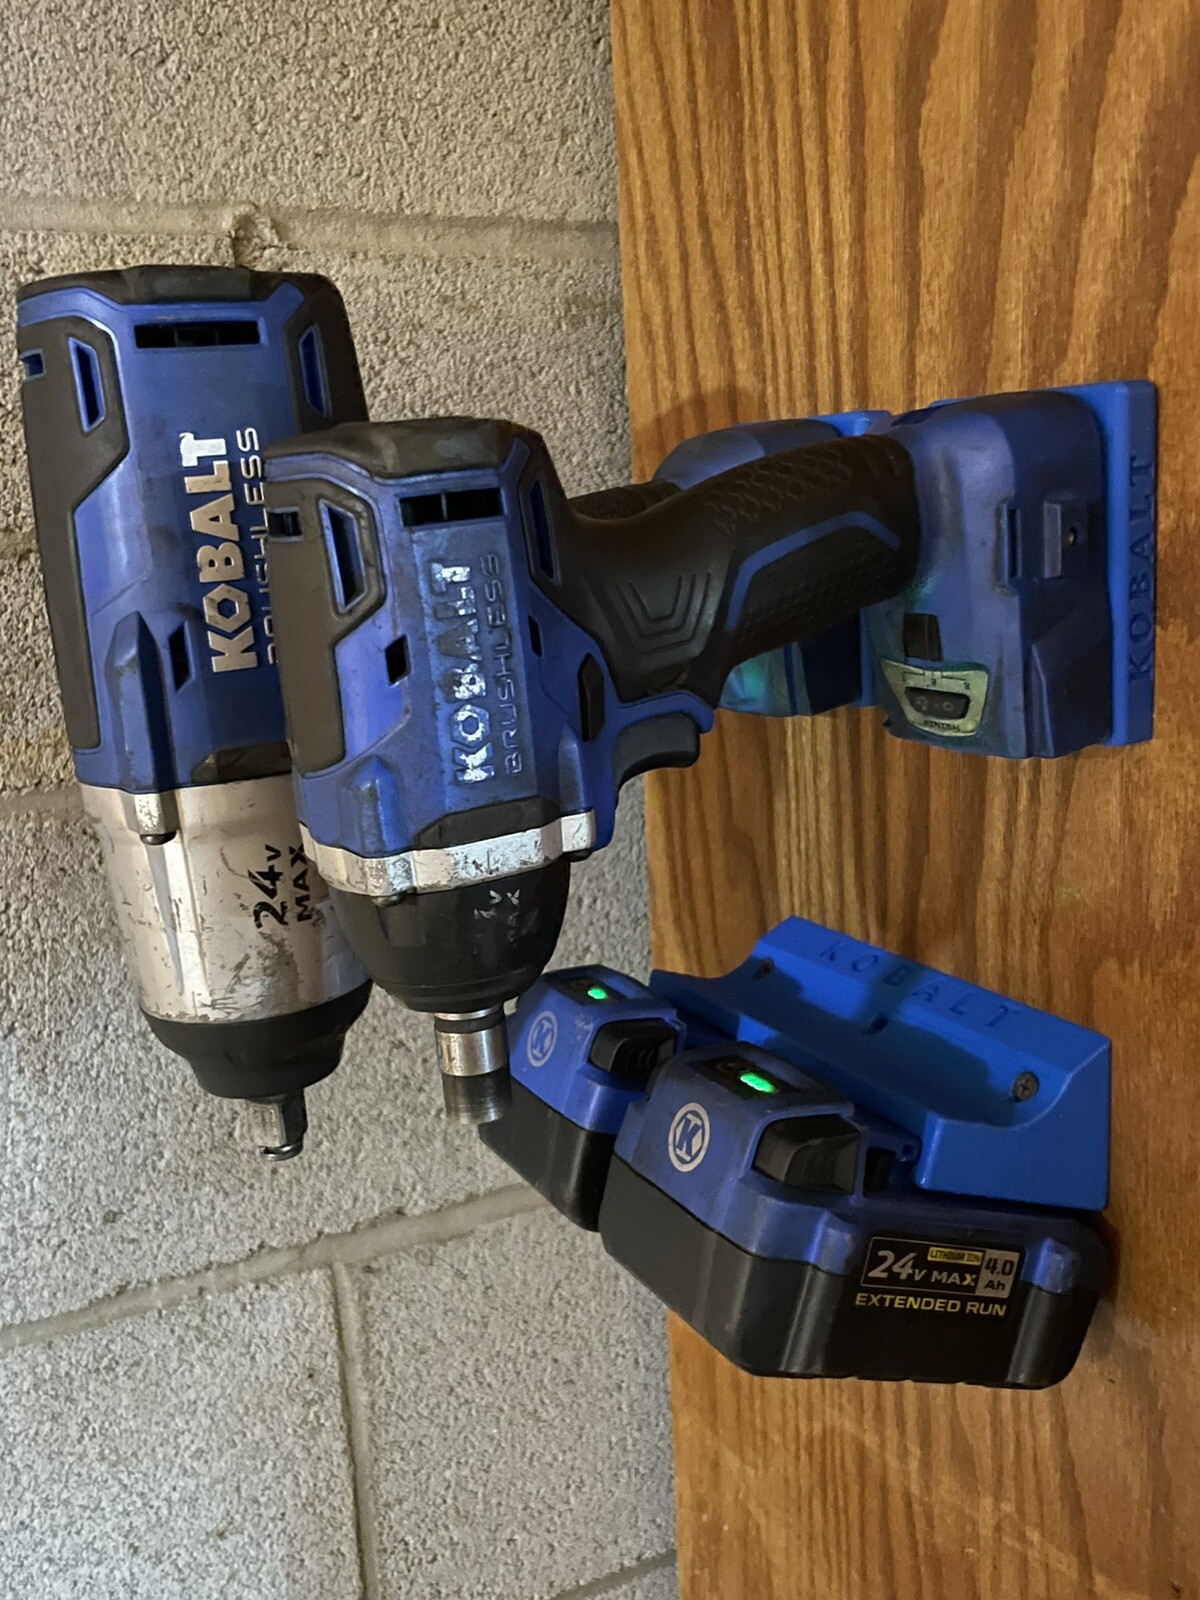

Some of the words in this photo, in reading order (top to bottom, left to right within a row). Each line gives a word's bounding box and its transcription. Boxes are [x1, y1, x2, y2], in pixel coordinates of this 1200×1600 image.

[179, 432, 258, 673] KOBALT
[1129, 456, 1154, 684] KOBALT
[429, 560, 496, 784] KOBALT
[480, 553, 524, 775] BRUSHLESS
[288, 842, 312, 923] MAX
[819, 940, 1022, 1028] KOBALT
[855, 1292, 961, 1314] EXTENDED
[965, 1301, 1008, 1317] RUN
[930, 1269, 978, 1287] MAX
[984, 1256, 1015, 1277] 4.0
[984, 1279, 1007, 1292] Ah
